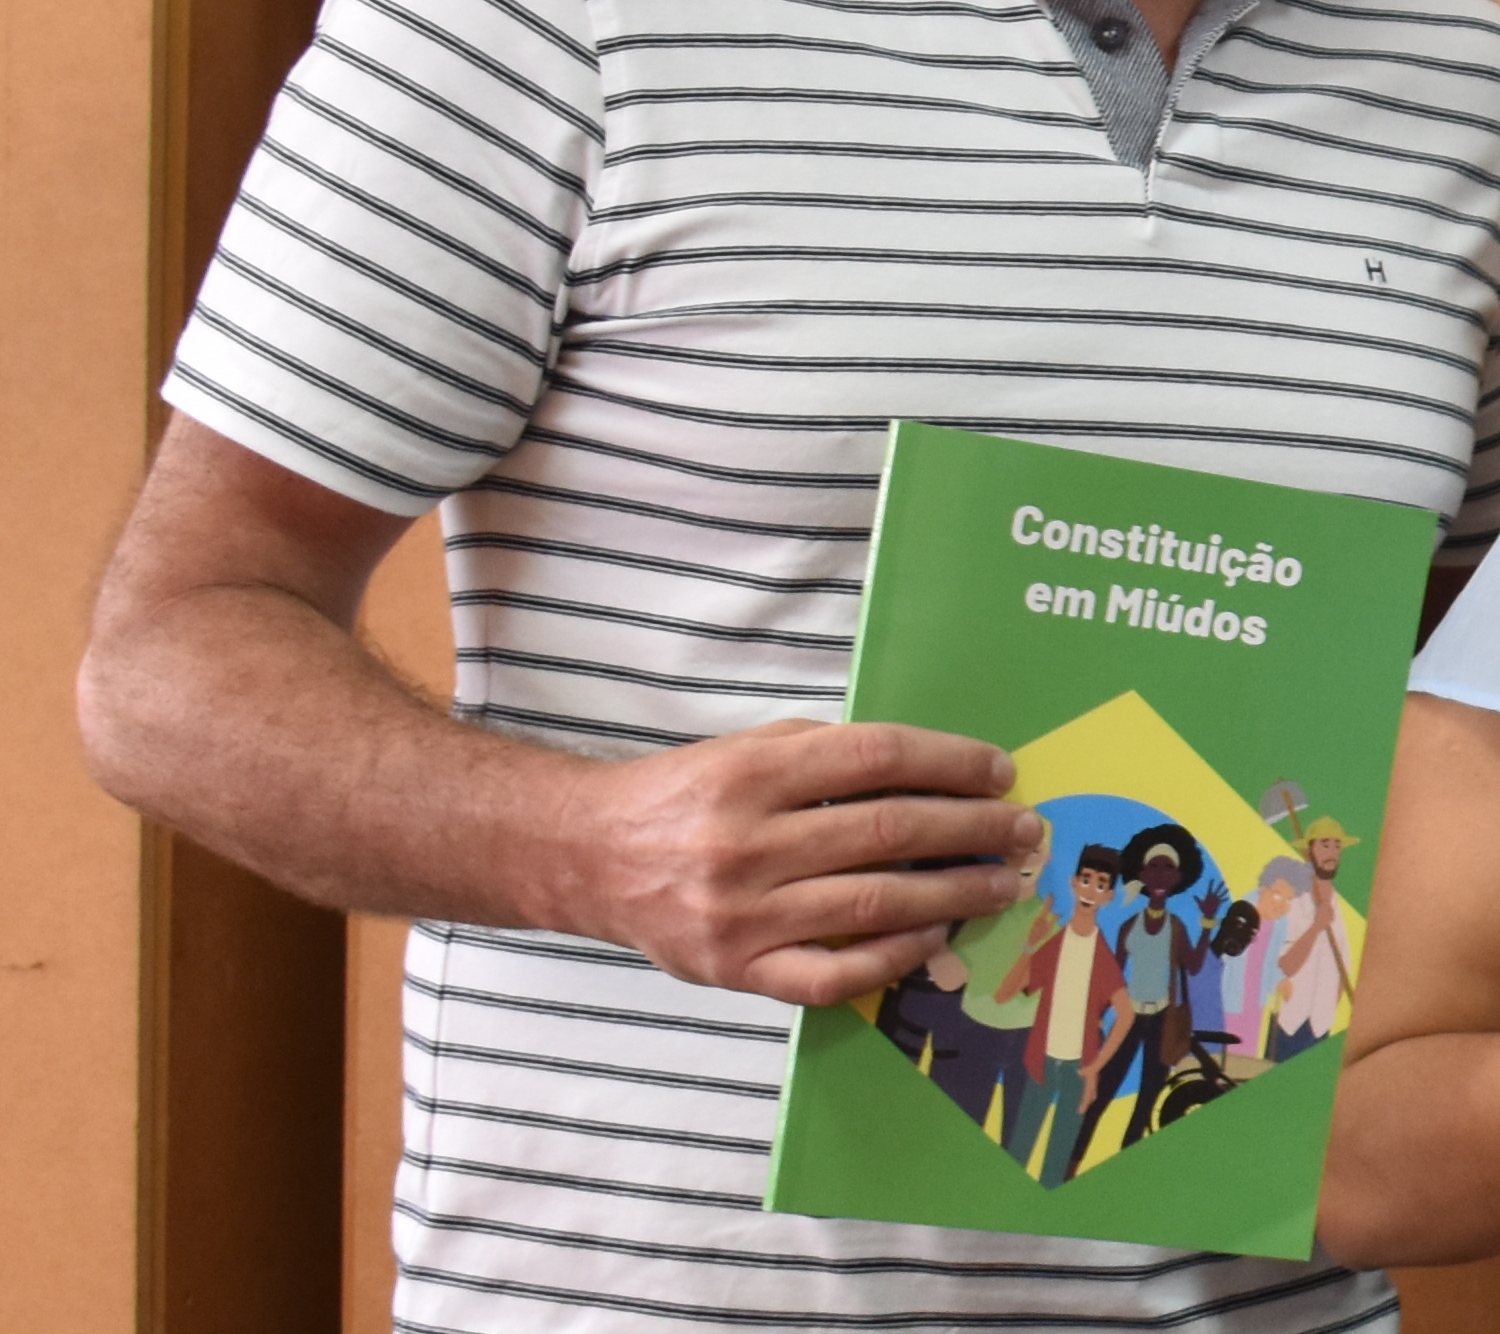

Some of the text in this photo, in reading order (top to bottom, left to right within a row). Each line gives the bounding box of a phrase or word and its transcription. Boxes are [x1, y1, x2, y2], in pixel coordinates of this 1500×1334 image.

[1365, 257, 1387, 283] H
[1012, 503, 1304, 591] Constituição
[1024, 579, 1269, 647] em Miúdos
